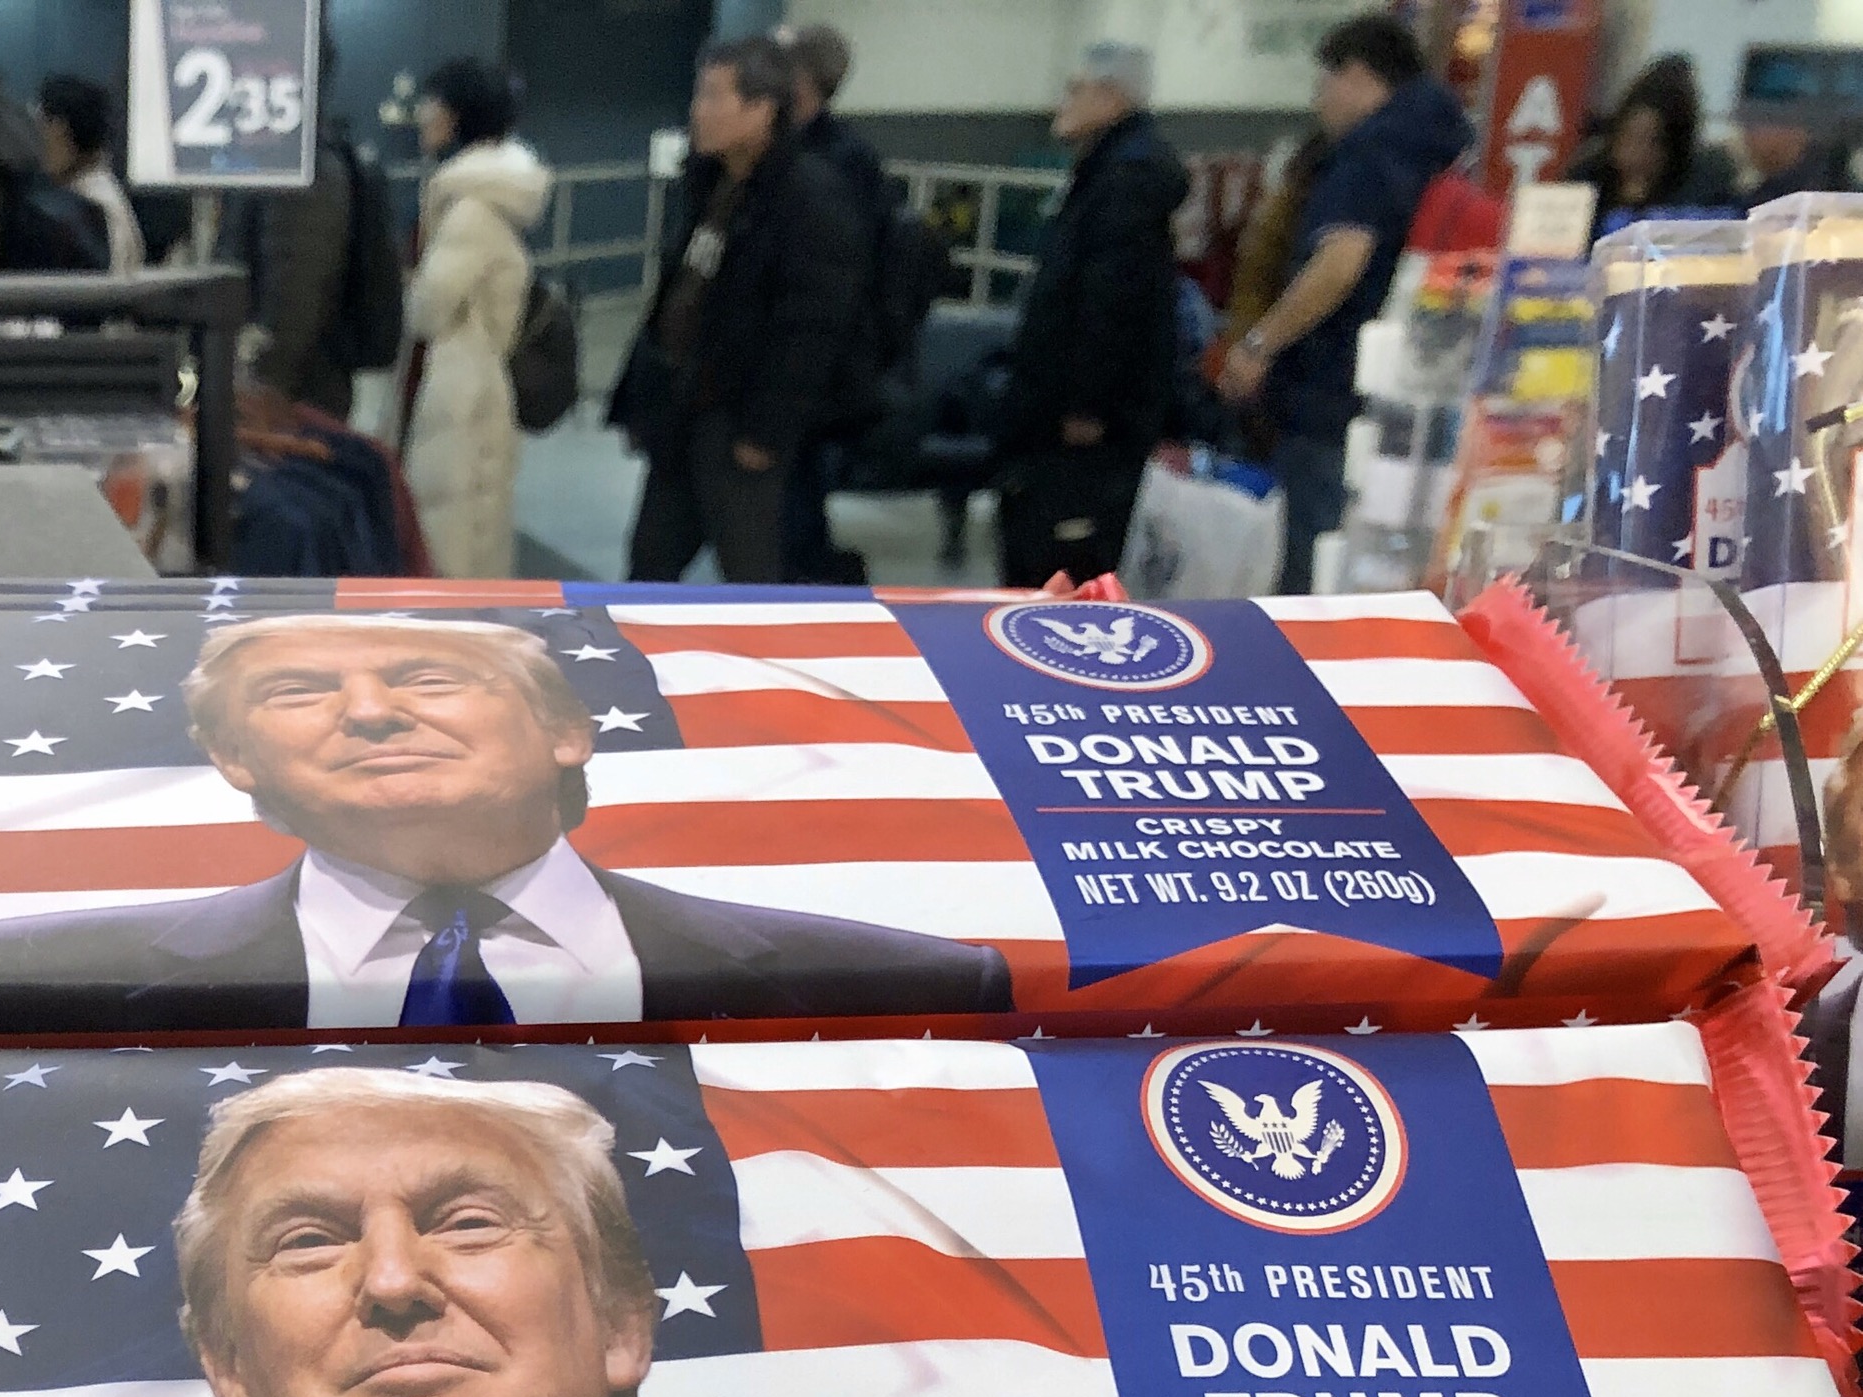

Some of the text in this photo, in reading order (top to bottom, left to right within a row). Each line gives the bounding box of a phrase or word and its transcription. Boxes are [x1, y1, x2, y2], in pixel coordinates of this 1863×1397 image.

[1003, 703, 1300, 726] 45th PRESIDENT
[1025, 734, 1320, 766] DONALD
[1061, 769, 1326, 802] TRUMP
[1135, 818, 1283, 836] CRISPY
[1062, 840, 1401, 861] MILK CHOCOLATE
[1077, 869, 1437, 907] NET WT. 9.2 OZ (260g)
[1148, 1263, 1494, 1303] 45th PRESIDENT
[1169, 1322, 1512, 1378] DONALD
